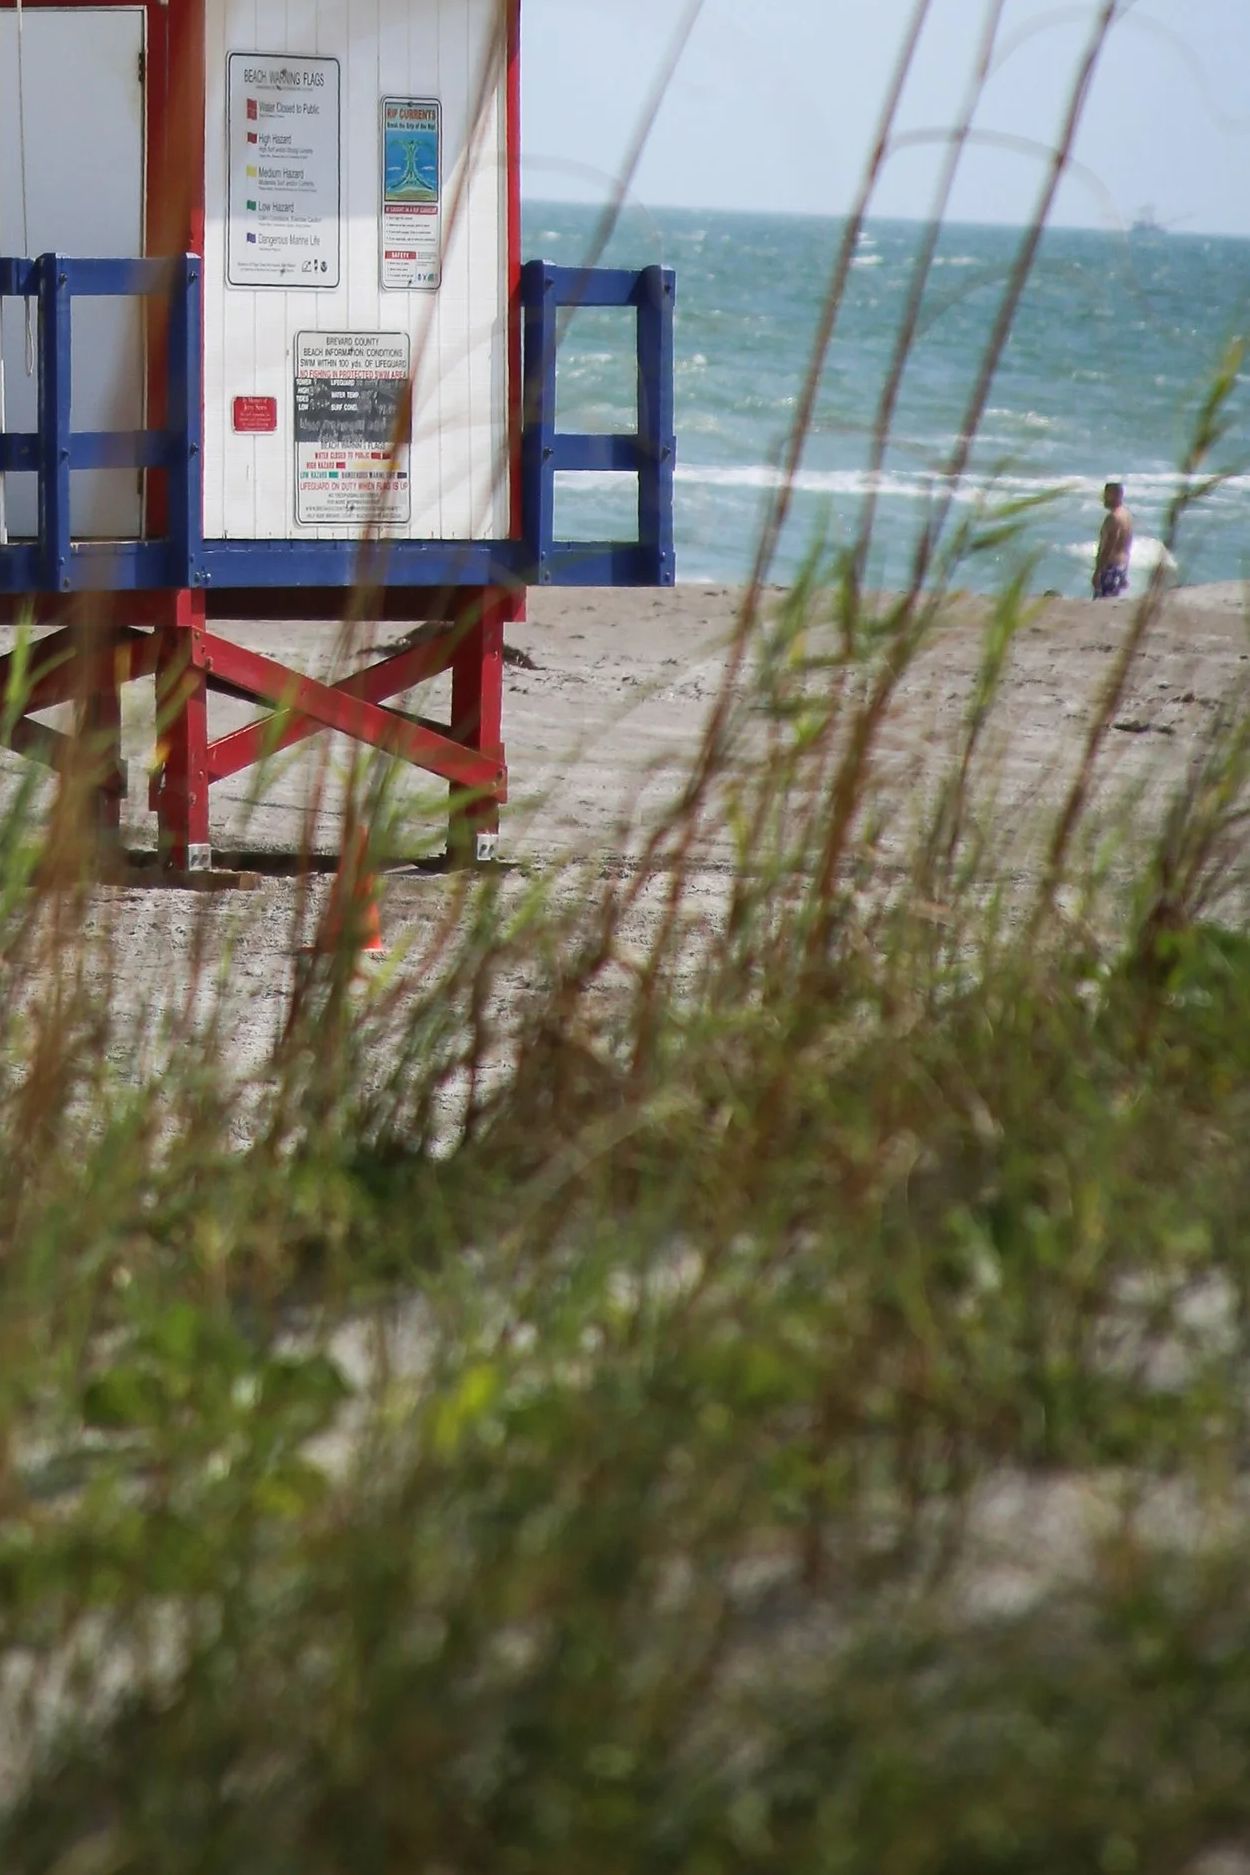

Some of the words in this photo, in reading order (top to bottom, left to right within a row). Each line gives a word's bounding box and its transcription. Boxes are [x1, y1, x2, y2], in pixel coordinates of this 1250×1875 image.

[244, 69, 267, 84] BEACH
[270, 70, 300, 85] WARNING
[303, 72, 325, 87] FLAGS
[260, 101, 275, 112] Water
[276, 102, 295, 114] Closed
[296, 103, 302, 113] to
[303, 103, 320, 115] Public
[387, 108, 398, 118] RIP
[258, 133, 271, 145] High
[272, 134, 292, 145] Hazard
[258, 166, 282, 178] Medium
[283, 168, 305, 179] Hazard
[258, 201, 271, 212] Low
[272, 201, 295, 213] Hazard
[258, 233, 288, 246] Dangerous
[289, 234, 309, 246] Marine
[310, 235, 321, 246] Life
[326, 337, 353, 346] BREVARD
[354, 337, 380, 346] COUNTY
[303, 348, 323, 356] BEACH
[325, 348, 364, 357] INFORMATION
[367, 349, 403, 357] CONDITIONS
[300, 358, 315, 367] SWIM
[318, 359, 337, 367] WITHIN
[339, 359, 349, 367] 100
[365, 359, 373, 368] OF
[375, 359, 407, 368] LIFEGUARD
[300, 370, 309, 378] NO
[310, 370, 332, 378] FISHING
[339, 370, 374, 378] PROTECTED
[296, 395, 310, 403] TIDES
[298, 403, 309, 411] LOW
[330, 403, 343, 411] SURF
[300, 482, 330, 491] LIFEGUARD
[331, 482, 340, 491] ON
[341, 482, 357, 491] DUTY
[358, 482, 375, 491] WHEN
[392, 482, 399, 491] IS
[400, 482, 408, 491] UP
